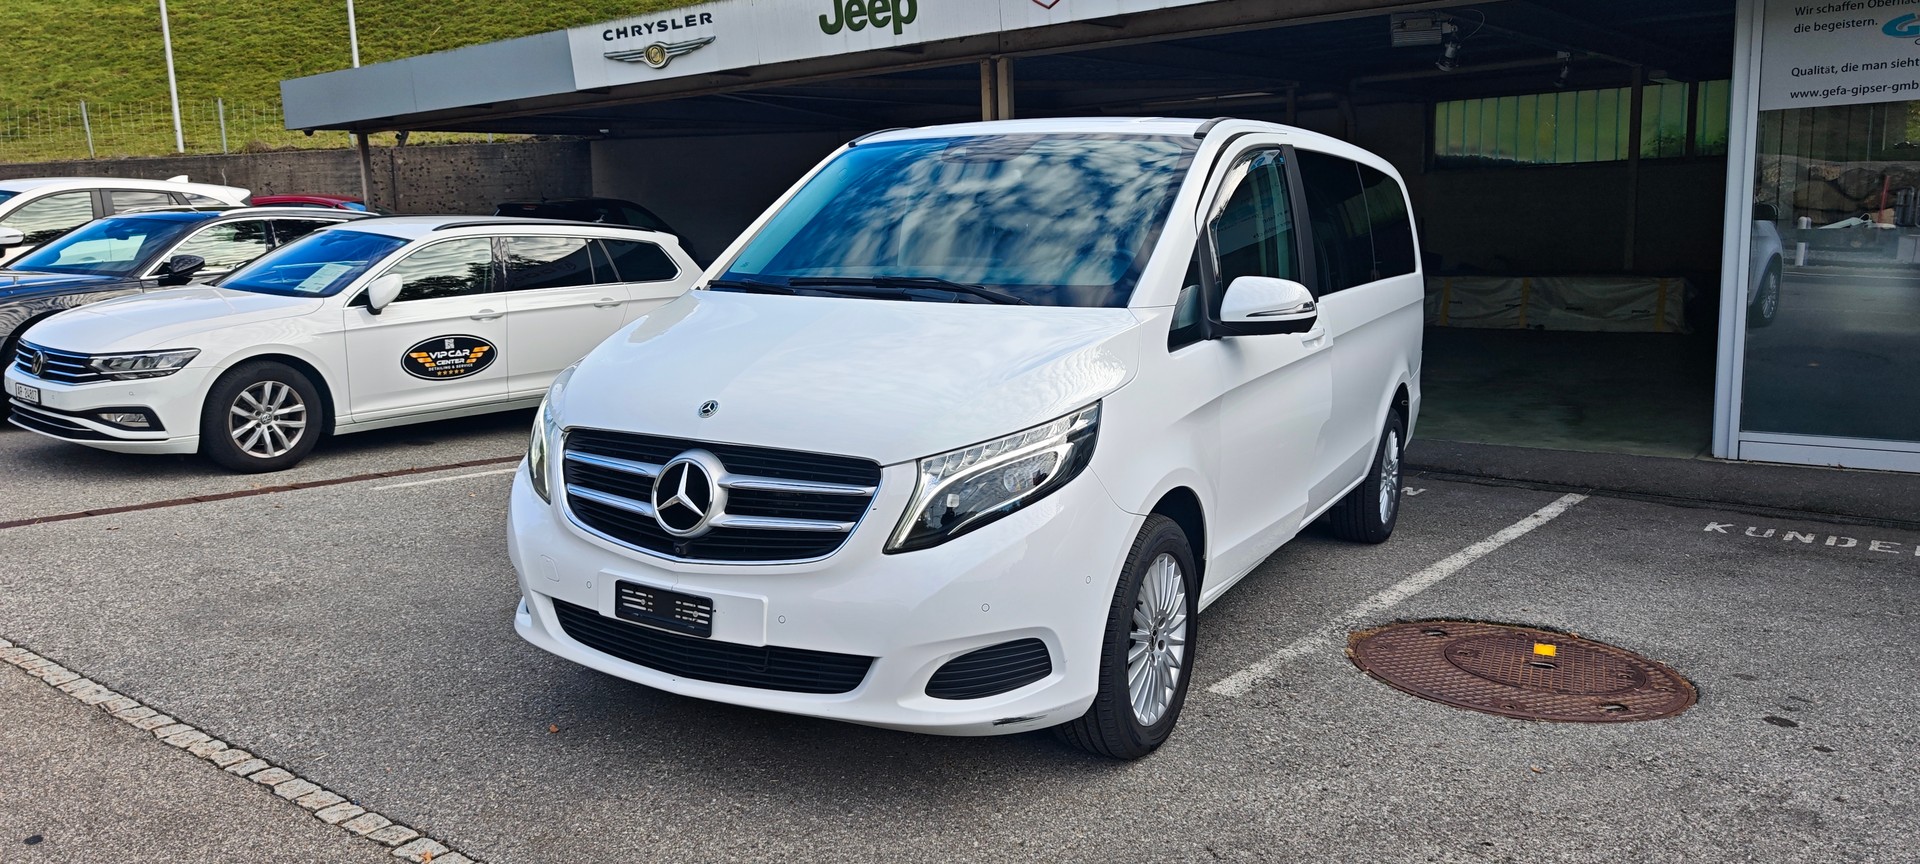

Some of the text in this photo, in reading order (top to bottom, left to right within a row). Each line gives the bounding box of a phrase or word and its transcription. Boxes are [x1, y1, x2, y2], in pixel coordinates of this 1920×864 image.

[818, 0, 917, 35] Jeep
[1794, 7, 1814, 16] Wir
[1816, 1, 1864, 14] schaffen
[602, 12, 713, 41] CHRYSLER
[1793, 18, 1878, 33] die begeistern.
[1791, 57, 1920, 77] Qualität, die man sieht
[429, 349, 470, 359] VIP CAR
[1703, 521, 1920, 557] KUNDE
